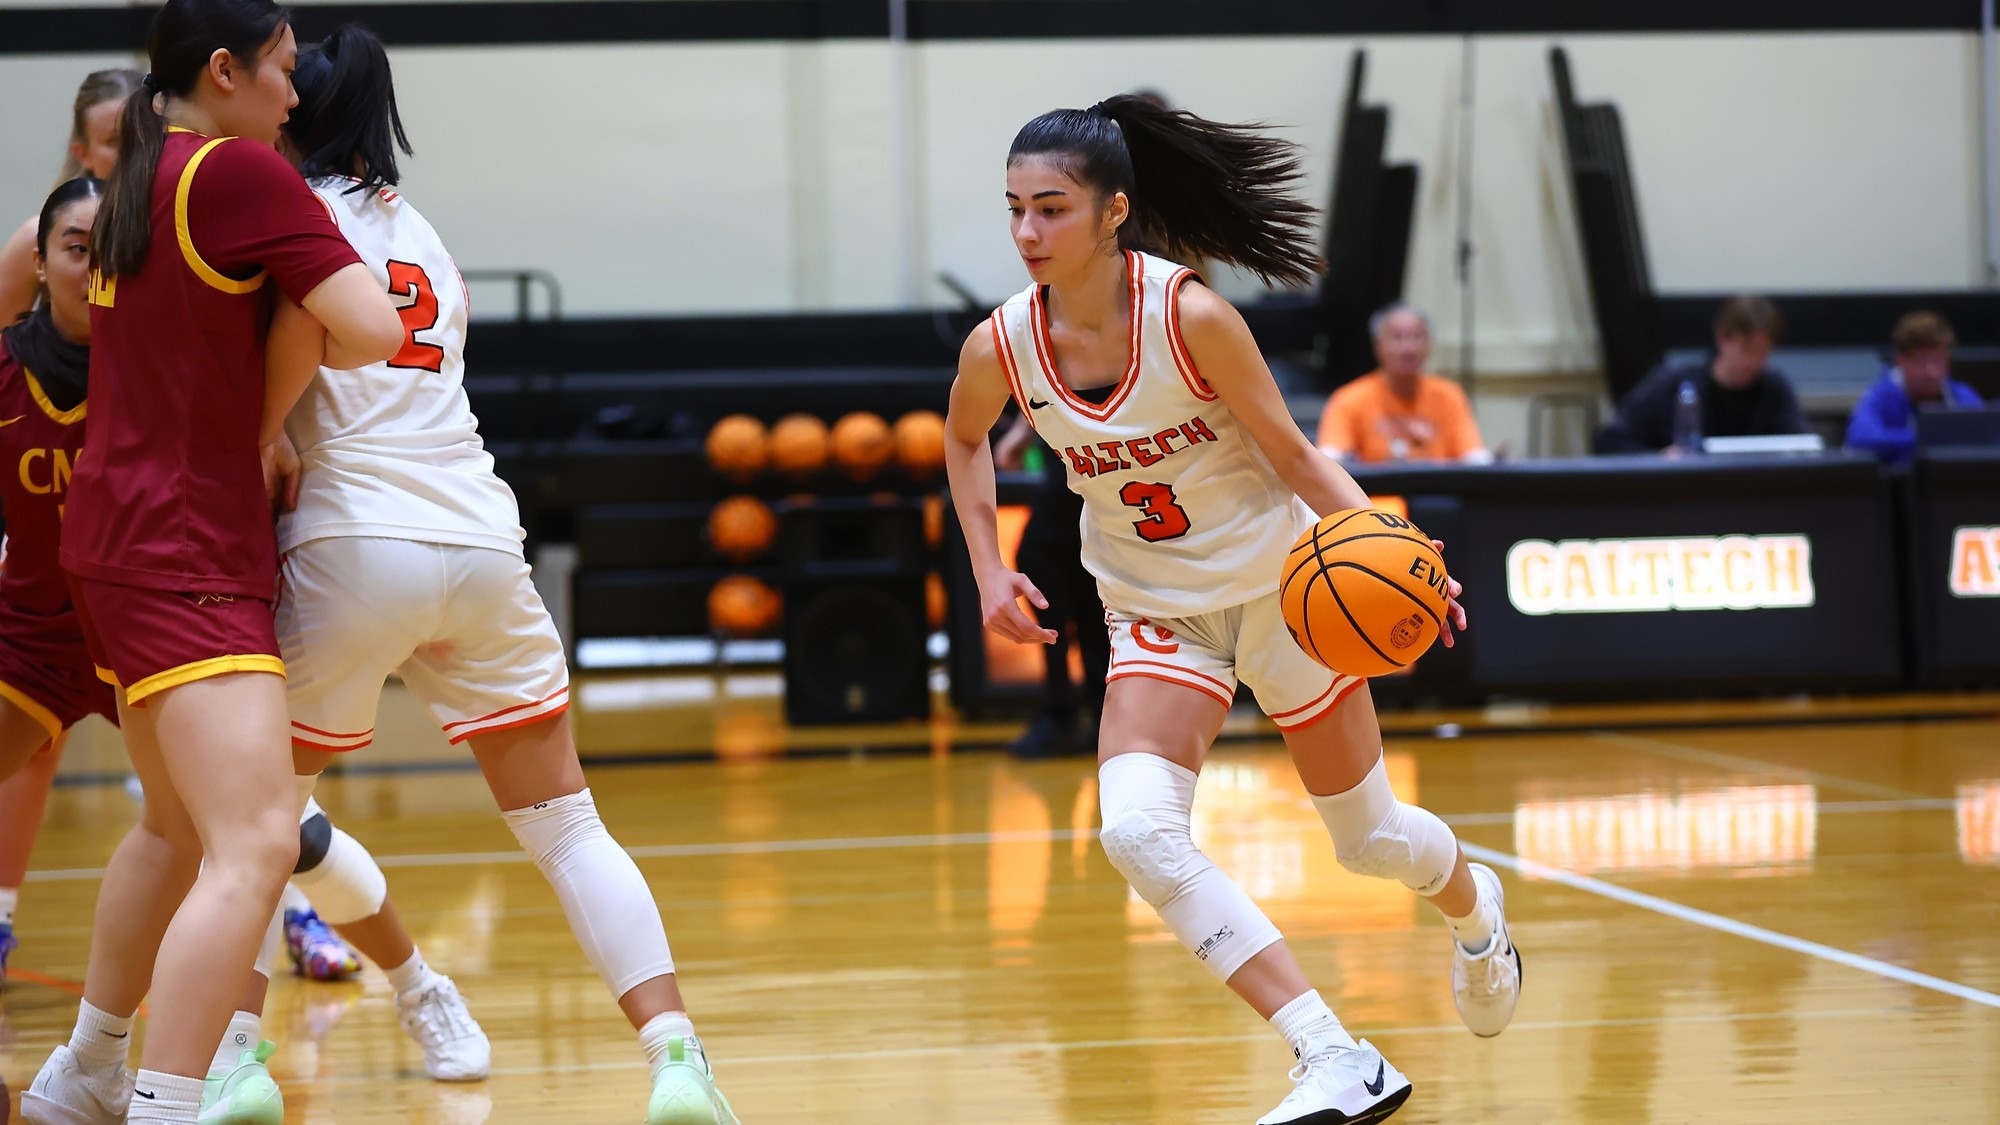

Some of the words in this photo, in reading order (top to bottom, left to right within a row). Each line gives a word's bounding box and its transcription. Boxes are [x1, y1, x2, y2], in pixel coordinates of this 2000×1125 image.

[386, 259, 444, 373] 2
[1054, 416, 1218, 478] ALTECH
[1119, 481, 1191, 542] 3
[1510, 537, 1812, 611] CALTECH
[1953, 530, 2000, 593] A
[1195, 927, 1227, 956] HEX
